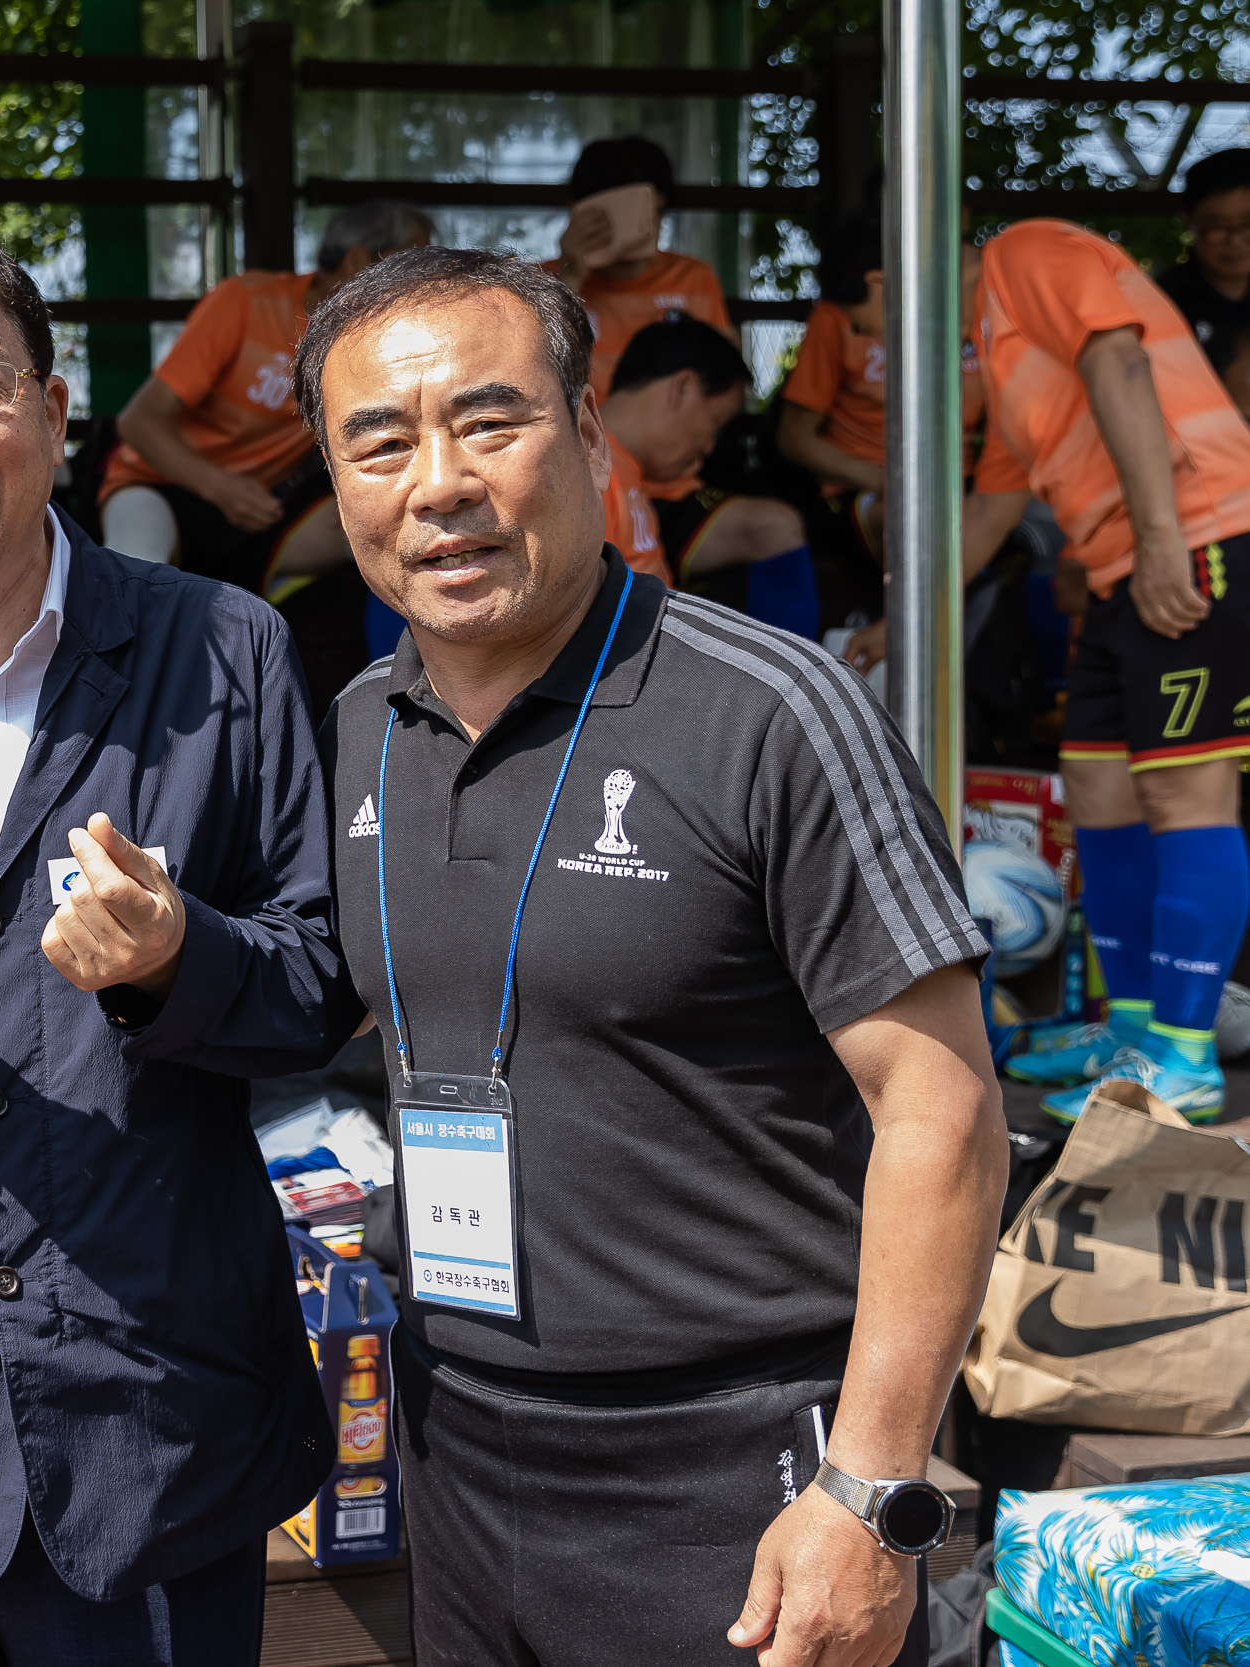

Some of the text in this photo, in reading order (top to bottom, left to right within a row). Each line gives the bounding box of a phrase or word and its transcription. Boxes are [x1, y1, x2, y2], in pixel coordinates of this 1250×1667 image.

[246, 365, 290, 410] 30
[1160, 666, 1210, 738] 7
[348, 821, 381, 838] adidas
[557, 858, 670, 882] KOREA REP. 2017
[578, 852, 646, 867] U-20 WORLD CUP
[406, 1121, 496, 1141] 서울시 장수축구대회
[435, 1271, 510, 1294] 한국장수축구협회
